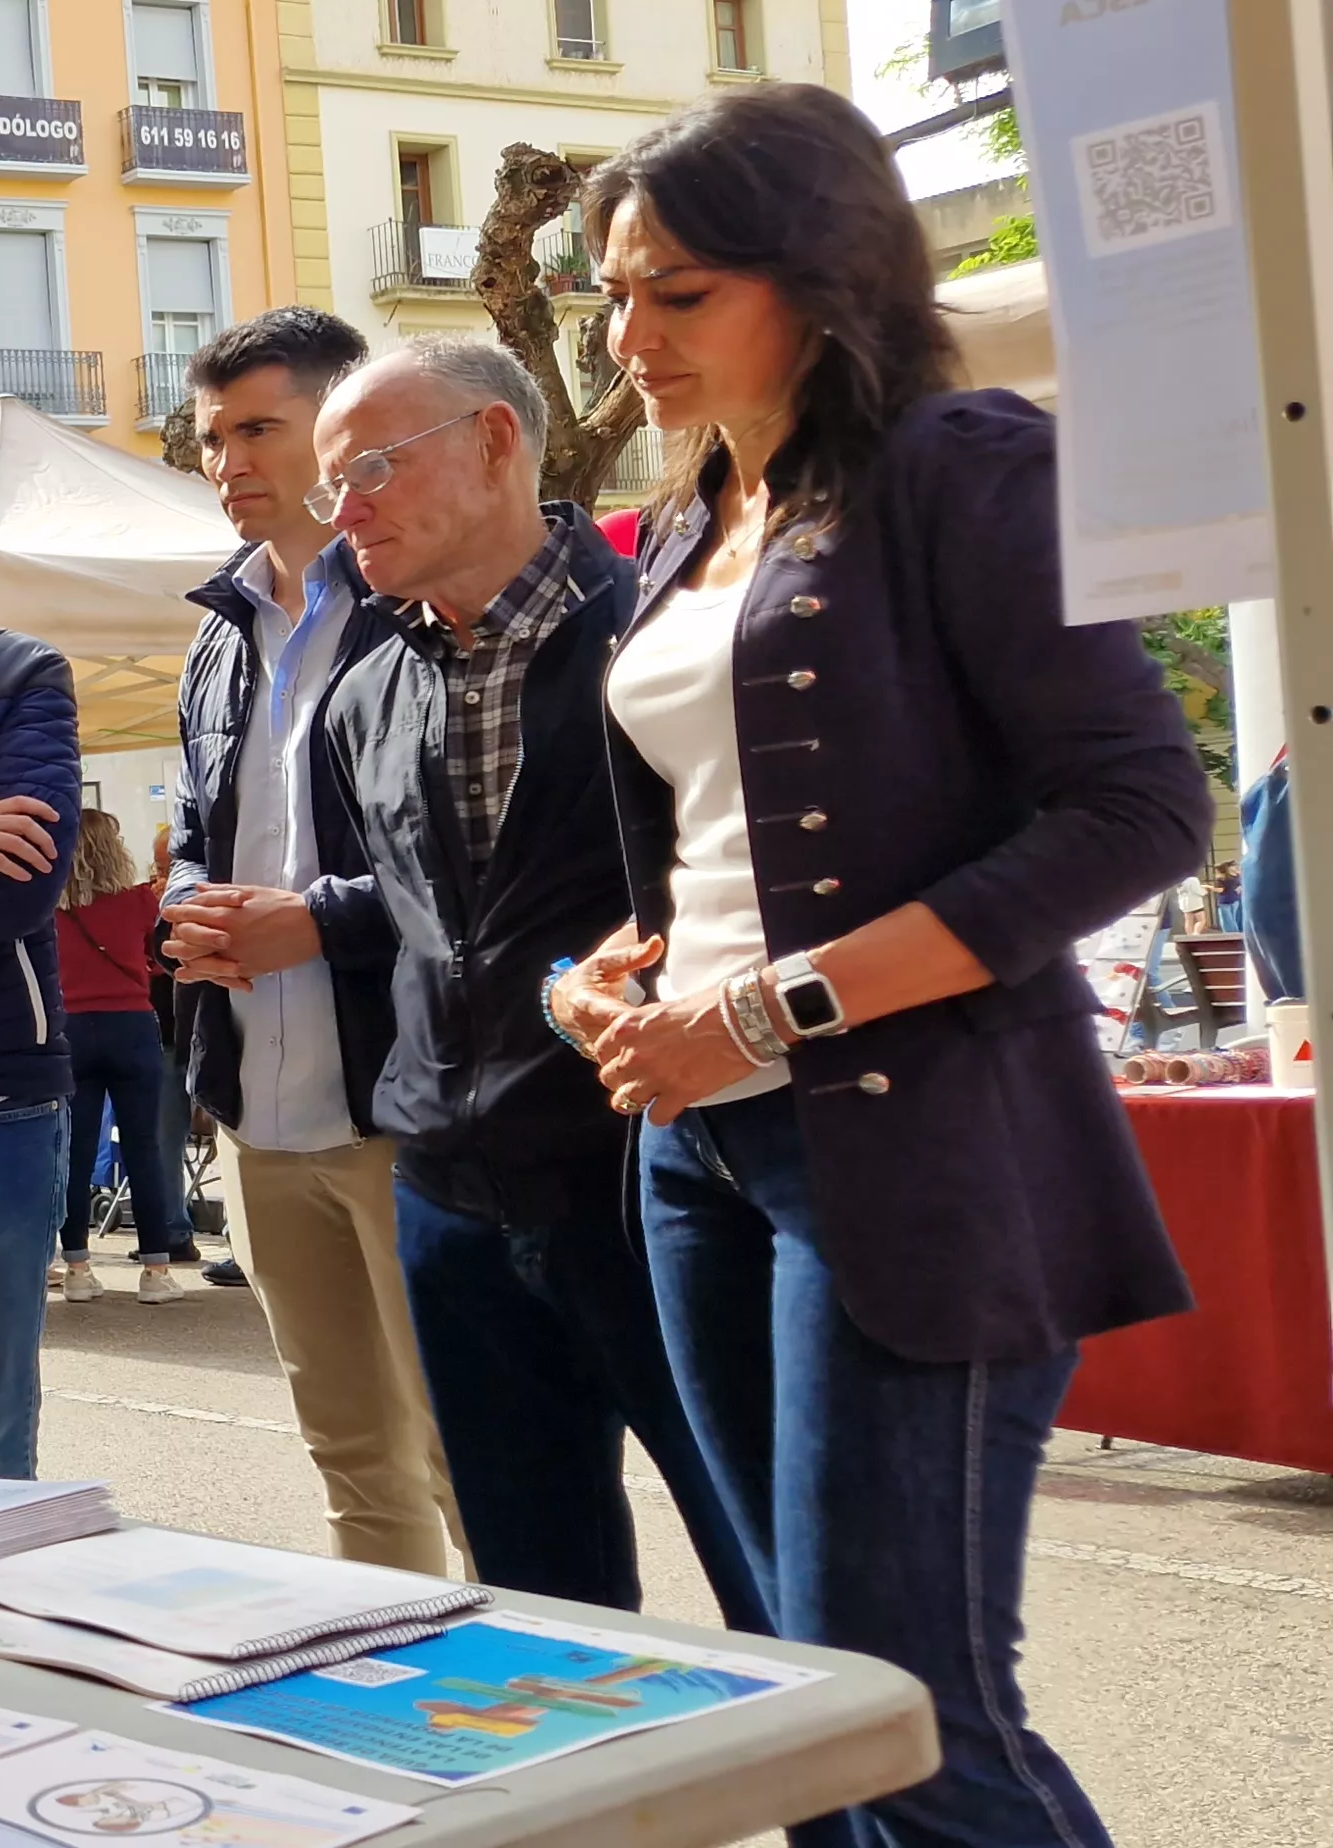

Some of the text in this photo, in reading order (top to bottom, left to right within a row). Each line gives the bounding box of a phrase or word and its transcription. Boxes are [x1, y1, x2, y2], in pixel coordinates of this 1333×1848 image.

[140, 126, 241, 151] 611 59 16 16
